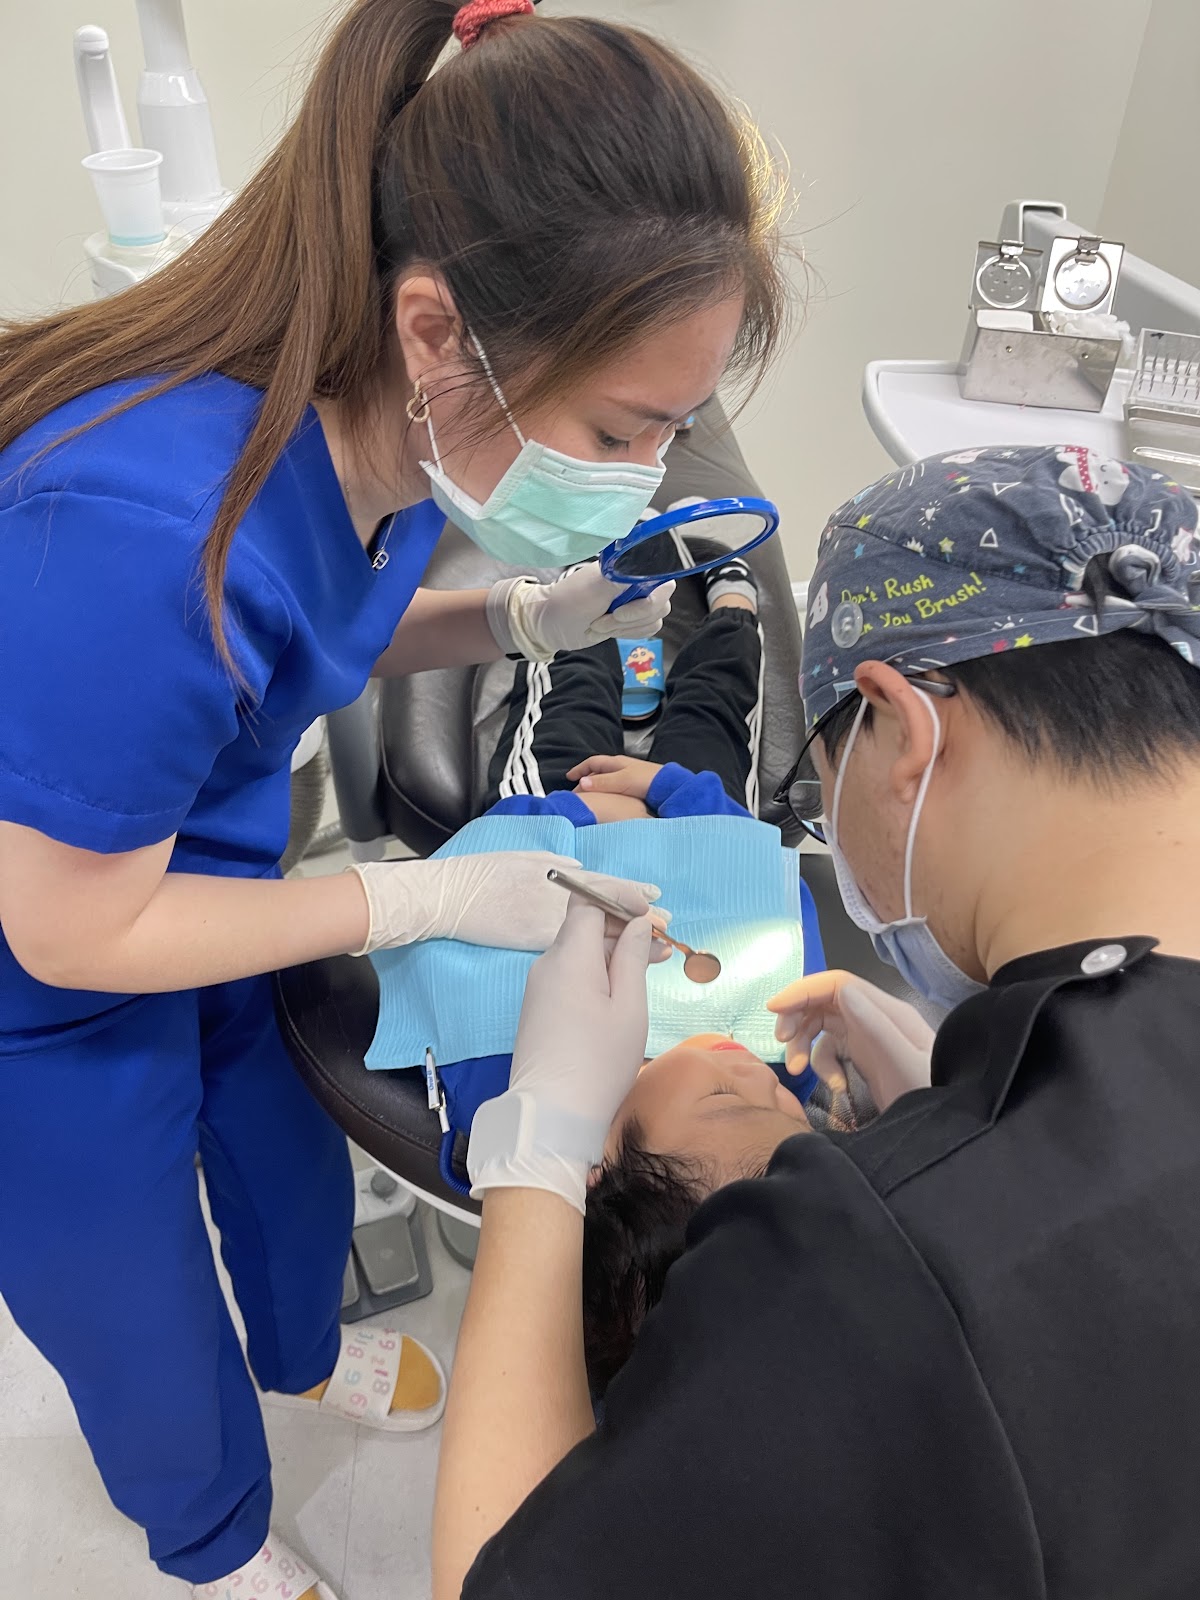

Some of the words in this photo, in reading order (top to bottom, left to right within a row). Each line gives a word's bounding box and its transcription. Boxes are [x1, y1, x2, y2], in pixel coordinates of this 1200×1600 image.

[879, 612, 912, 628] You
[915, 572, 987, 619] Brush!
[884, 574, 934, 599] Rush
